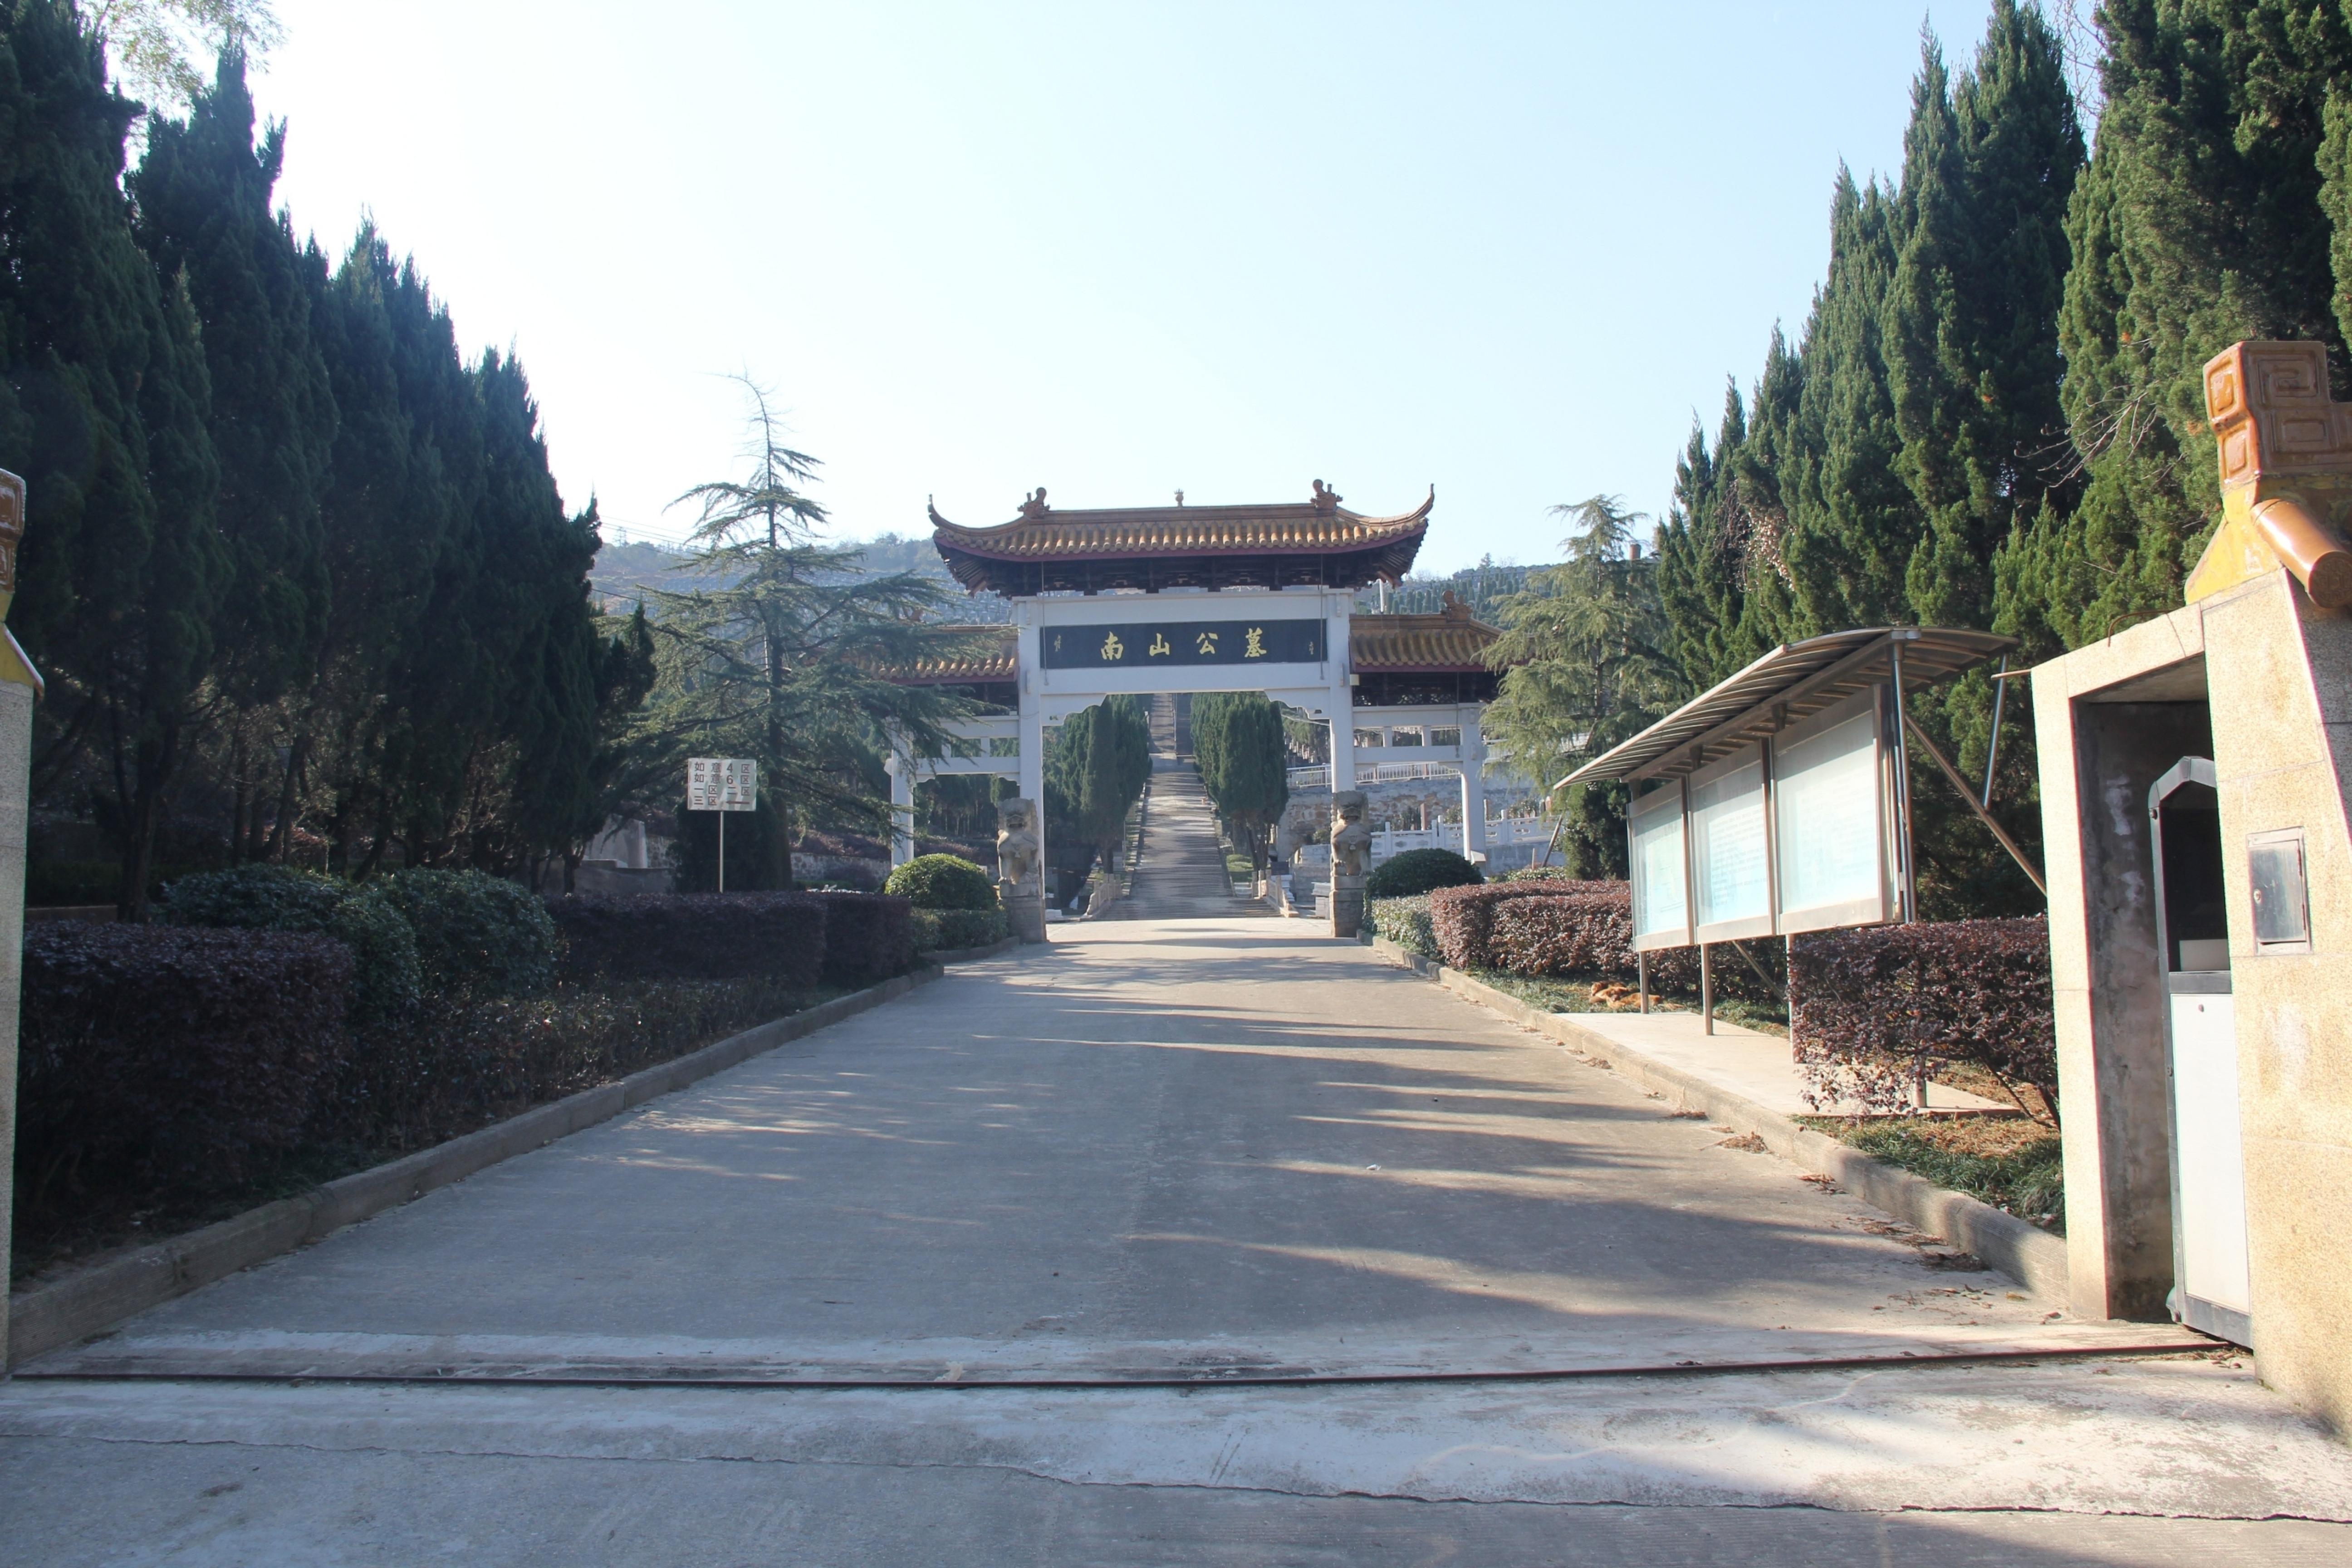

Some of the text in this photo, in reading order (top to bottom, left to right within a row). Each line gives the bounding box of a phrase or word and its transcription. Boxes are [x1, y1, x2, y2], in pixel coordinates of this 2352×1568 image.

[1100, 627, 1267, 661] 南山公墓
[694, 762, 750, 773] 如意4区
[694, 773, 750, 784] 如意6区
[694, 785, 750, 795] 一区 二区
[694, 796, 717, 805] 三区
